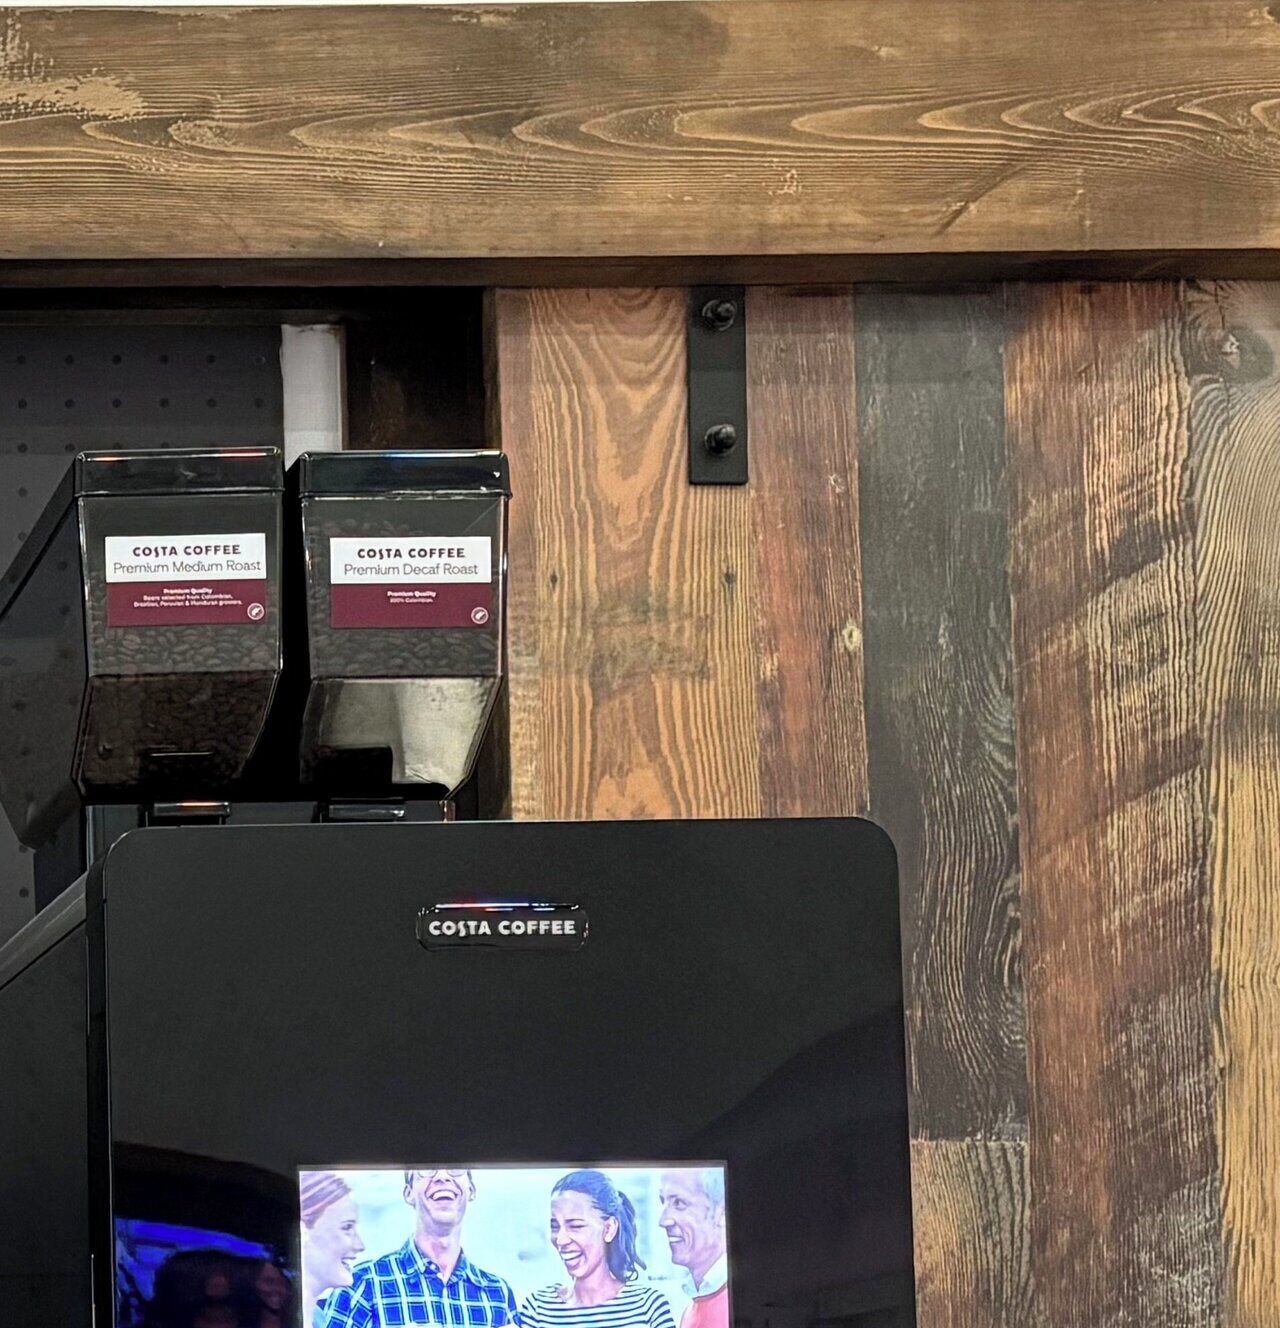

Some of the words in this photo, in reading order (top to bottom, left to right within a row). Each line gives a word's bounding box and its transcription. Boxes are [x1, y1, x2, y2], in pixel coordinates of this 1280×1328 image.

[132, 545, 178, 558] COSTA
[183, 544, 242, 556] COFFEE
[357, 548, 403, 560] COSTA
[408, 547, 466, 559] COFFEE
[113, 561, 170, 575] Premium
[172, 560, 223, 573] Medium
[226, 559, 262, 572] Roast
[344, 563, 400, 576] Premium
[403, 562, 441, 576] Decaf
[443, 563, 479, 575] Roast
[428, 920, 492, 937] COSTA
[497, 919, 577, 936] COFFEE
